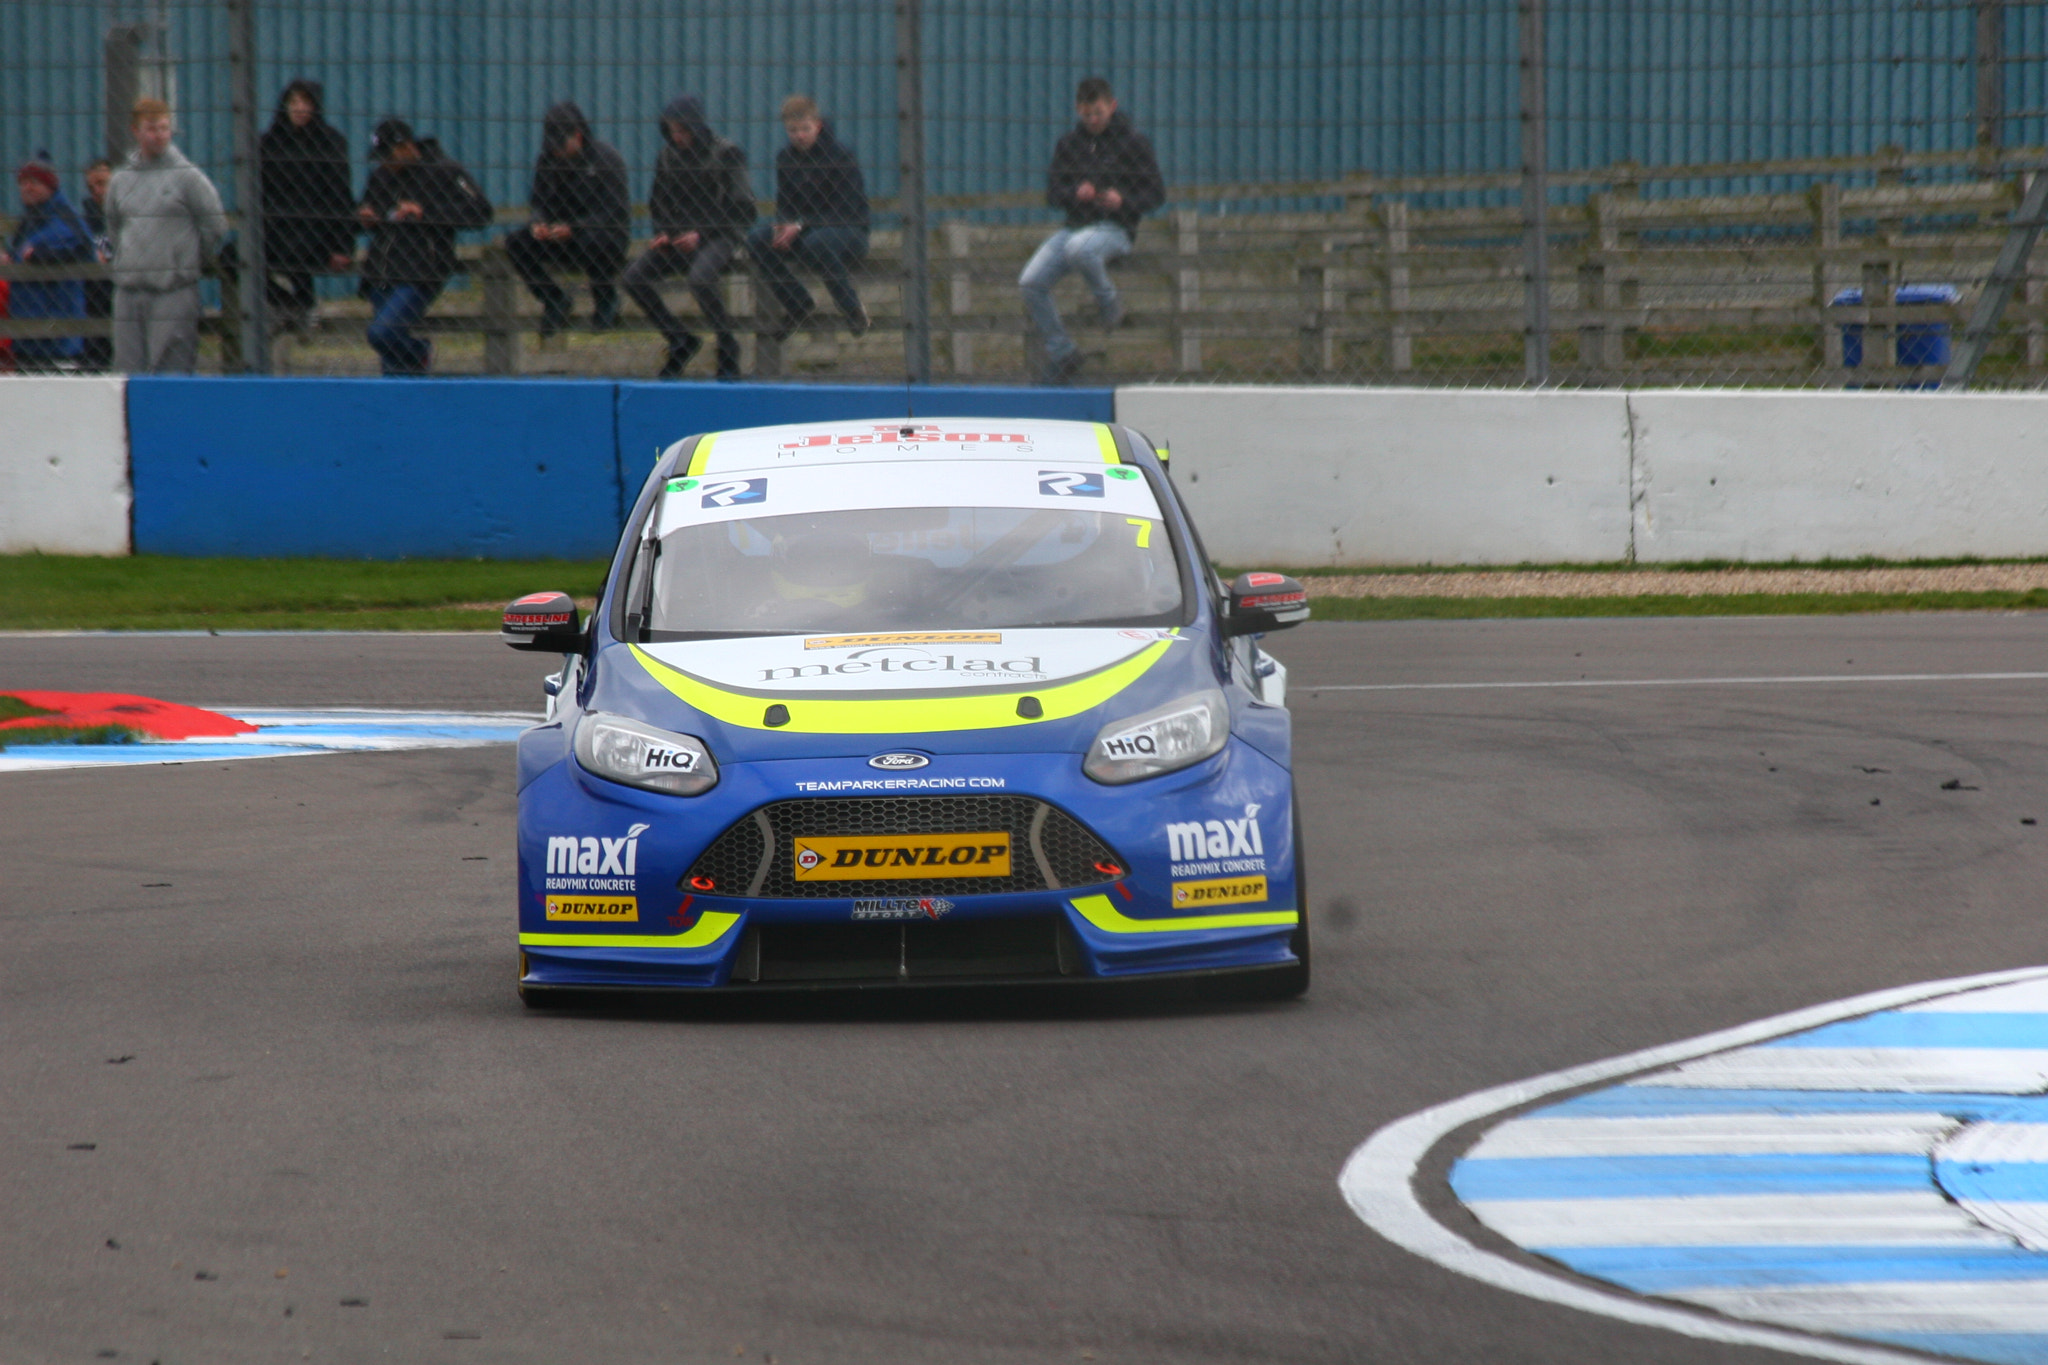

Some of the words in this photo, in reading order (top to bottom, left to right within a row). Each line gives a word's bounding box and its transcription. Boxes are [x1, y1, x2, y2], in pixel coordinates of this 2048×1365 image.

[779, 432, 1034, 450] Jelson
[778, 443, 1034, 459] HOMES
[1125, 518, 1152, 549] 7
[503, 613, 571, 623] STRESSLINE
[841, 634, 999, 644] DUNLOP
[758, 654, 1048, 682] metclad
[959, 670, 1048, 680] contracts
[1106, 735, 1157, 755] HiQ
[646, 748, 694, 769] HiQ
[882, 755, 914, 766] Ford
[1166, 803, 1264, 862] maxi
[546, 823, 650, 876] maxi
[831, 845, 1008, 868] DUNLOP
[1170, 862, 1222, 878] READYMIX
[1222, 858, 1267, 874] CONCRETE
[545, 878, 587, 890] READYMIX
[589, 878, 637, 891] CONCRETE
[1192, 883, 1264, 900] DUNLOP
[560, 902, 634, 915] DUNLOP
[858, 911, 917, 919] SPORT
[667, 916, 695, 928] TOW
